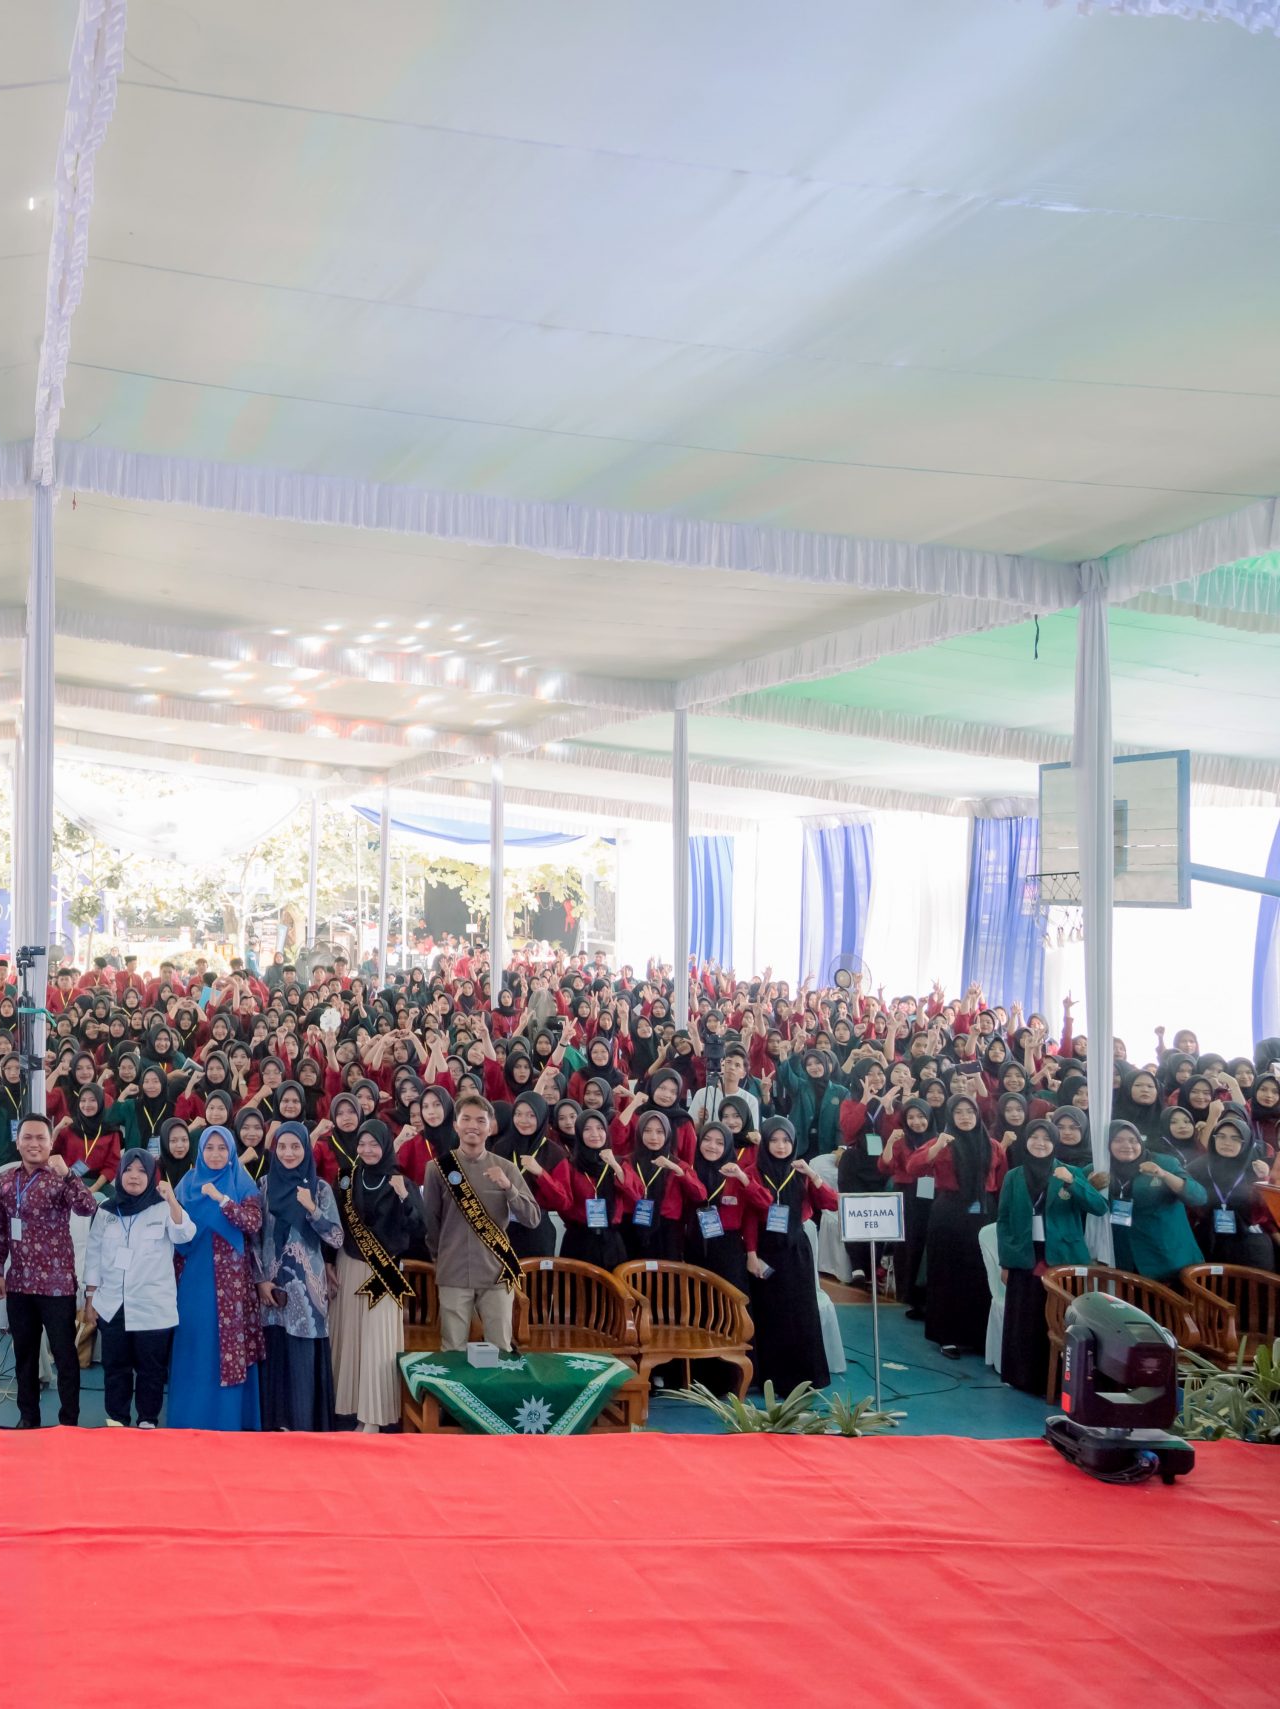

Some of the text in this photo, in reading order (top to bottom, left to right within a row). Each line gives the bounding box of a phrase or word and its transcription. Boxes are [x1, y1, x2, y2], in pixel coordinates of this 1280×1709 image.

[469, 1199, 482, 1216] BACA
[848, 1208, 895, 1218] MASTAMA
[864, 1221, 879, 1229] FEB
[360, 1239, 374, 1256] 2024
